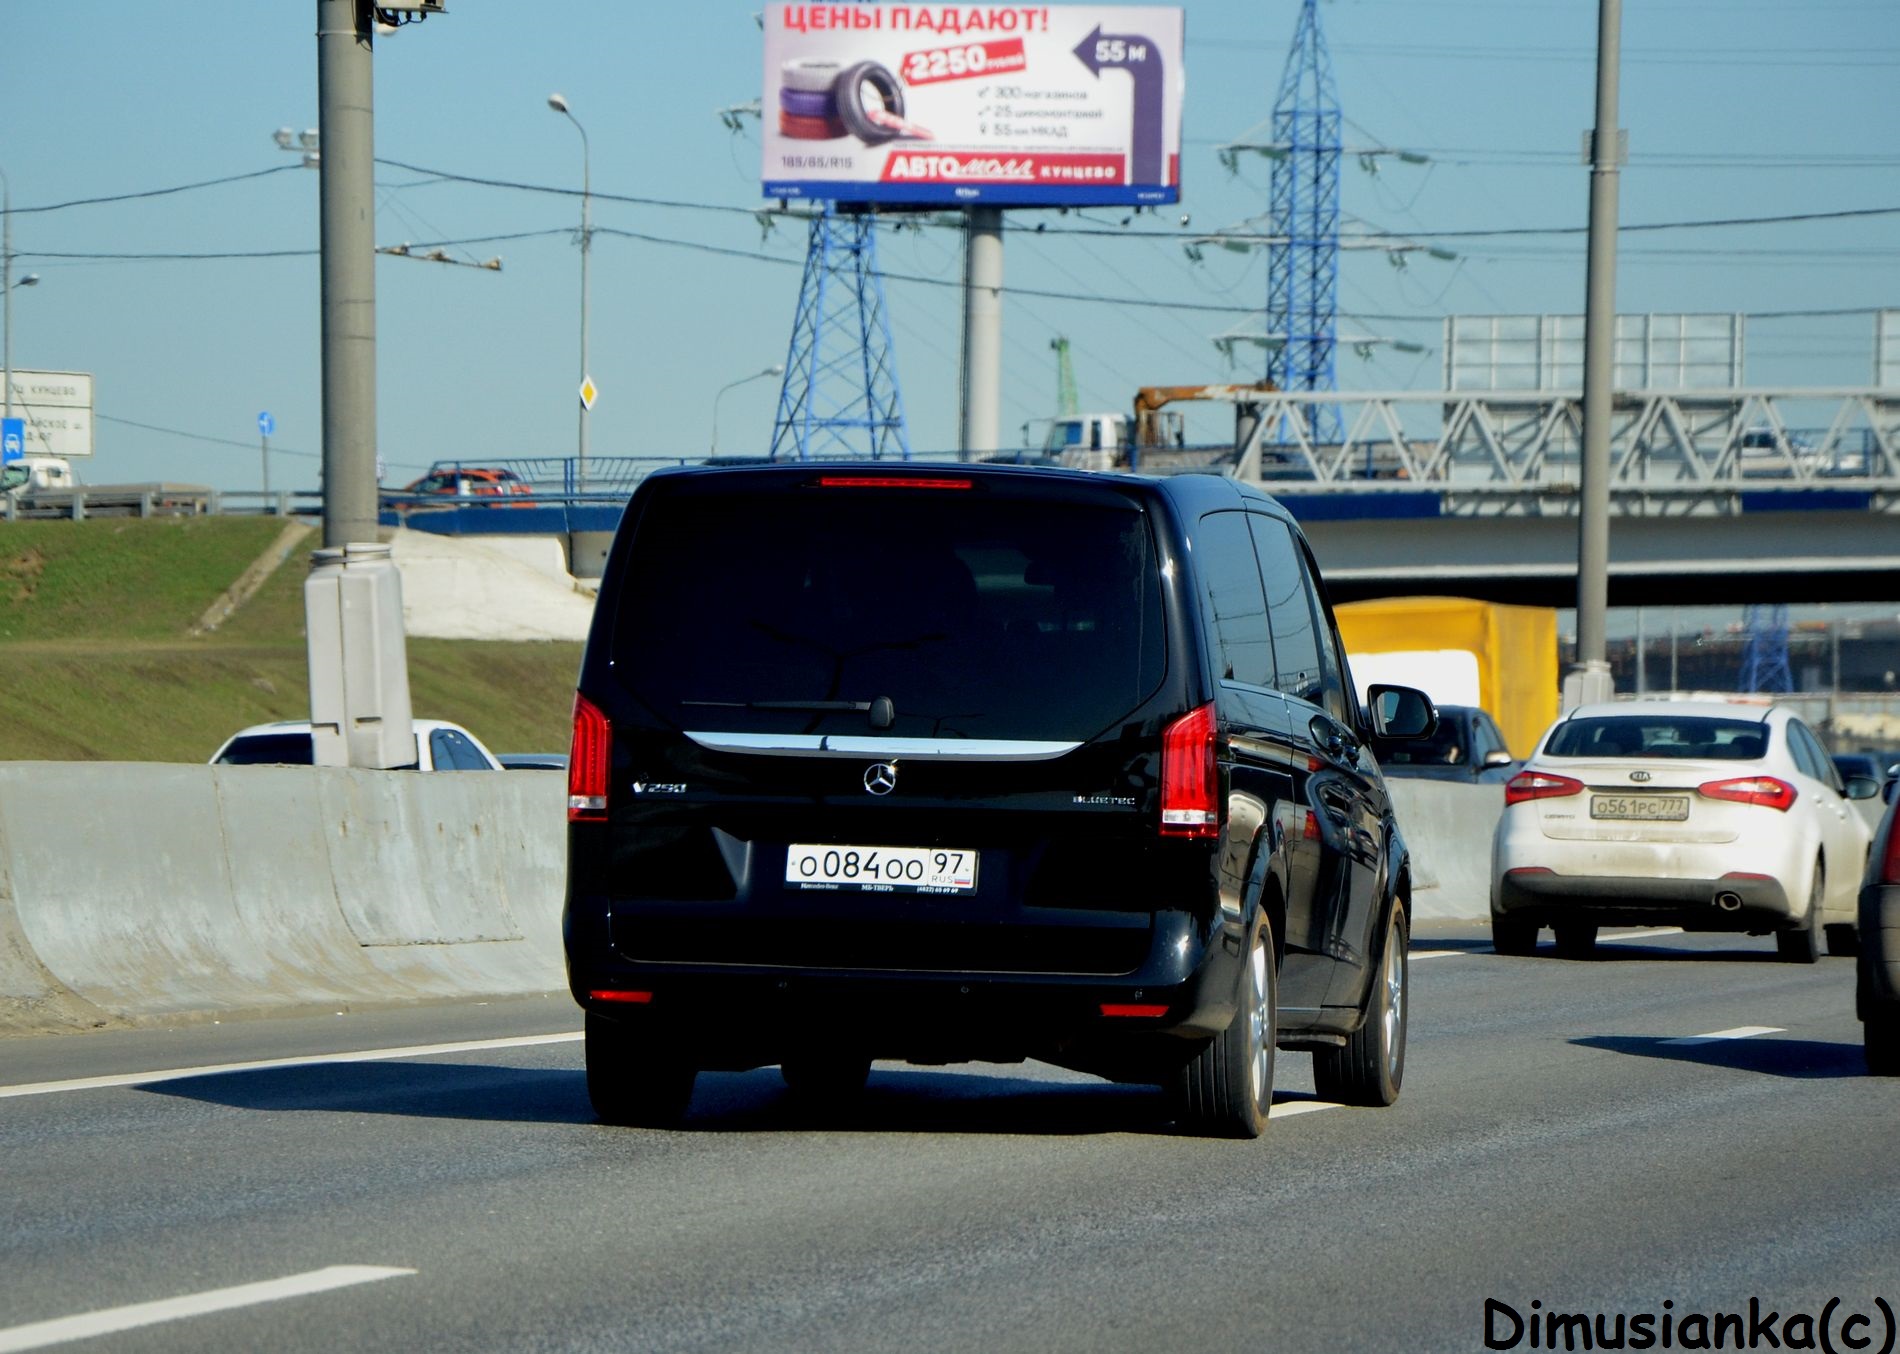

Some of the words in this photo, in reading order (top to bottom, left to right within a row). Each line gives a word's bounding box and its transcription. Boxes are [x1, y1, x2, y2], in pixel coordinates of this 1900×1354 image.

[784, 7, 881, 32] ЦЕНЫ
[891, 9, 1049, 34] ПАДАЮТ!
[1095, 40, 1126, 62] 55
[1040, 167, 1116, 179] КУНЦЕВО
[633, 781, 647, 793] V
[648, 783, 687, 793] 250
[934, 853, 964, 874] 97
[931, 875, 953, 884] RUS
